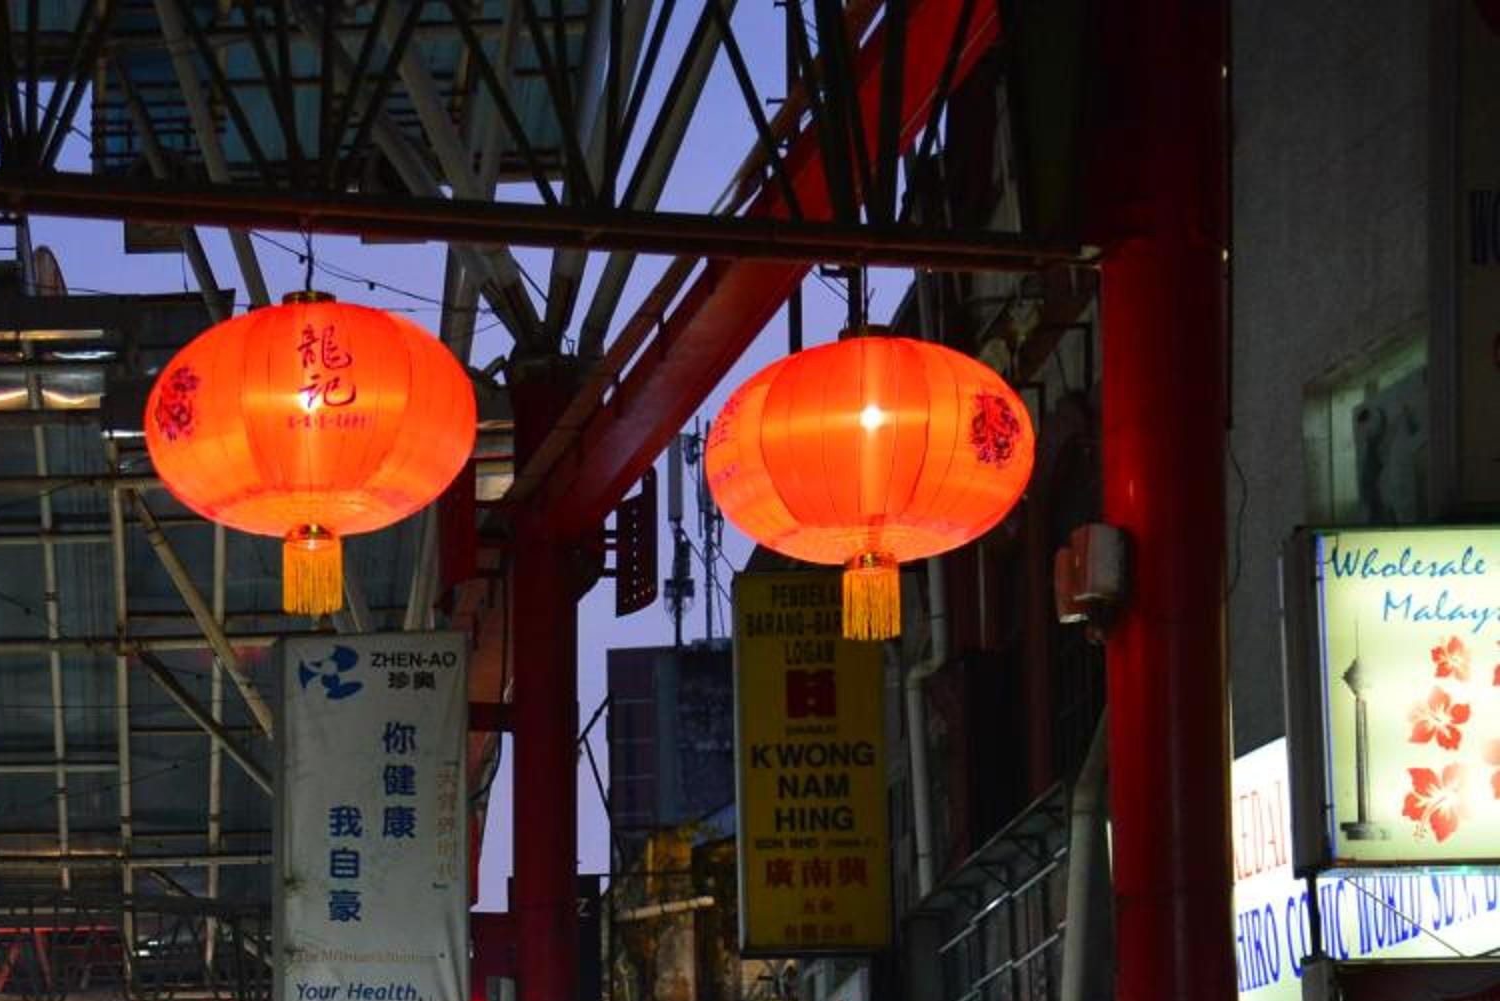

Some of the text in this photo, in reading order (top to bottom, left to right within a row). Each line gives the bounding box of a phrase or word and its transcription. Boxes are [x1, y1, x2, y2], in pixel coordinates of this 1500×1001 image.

[1331, 545, 1487, 579] Wholesale
[371, 651, 457, 669] ZHEN-AO
[750, 741, 876, 769] KWONG
[381, 721, 419, 840] 你健康
[778, 774, 850, 800] NAM
[775, 805, 854, 832] HING
[328, 804, 364, 924] 我自豪
[296, 983, 340, 1001] Your
